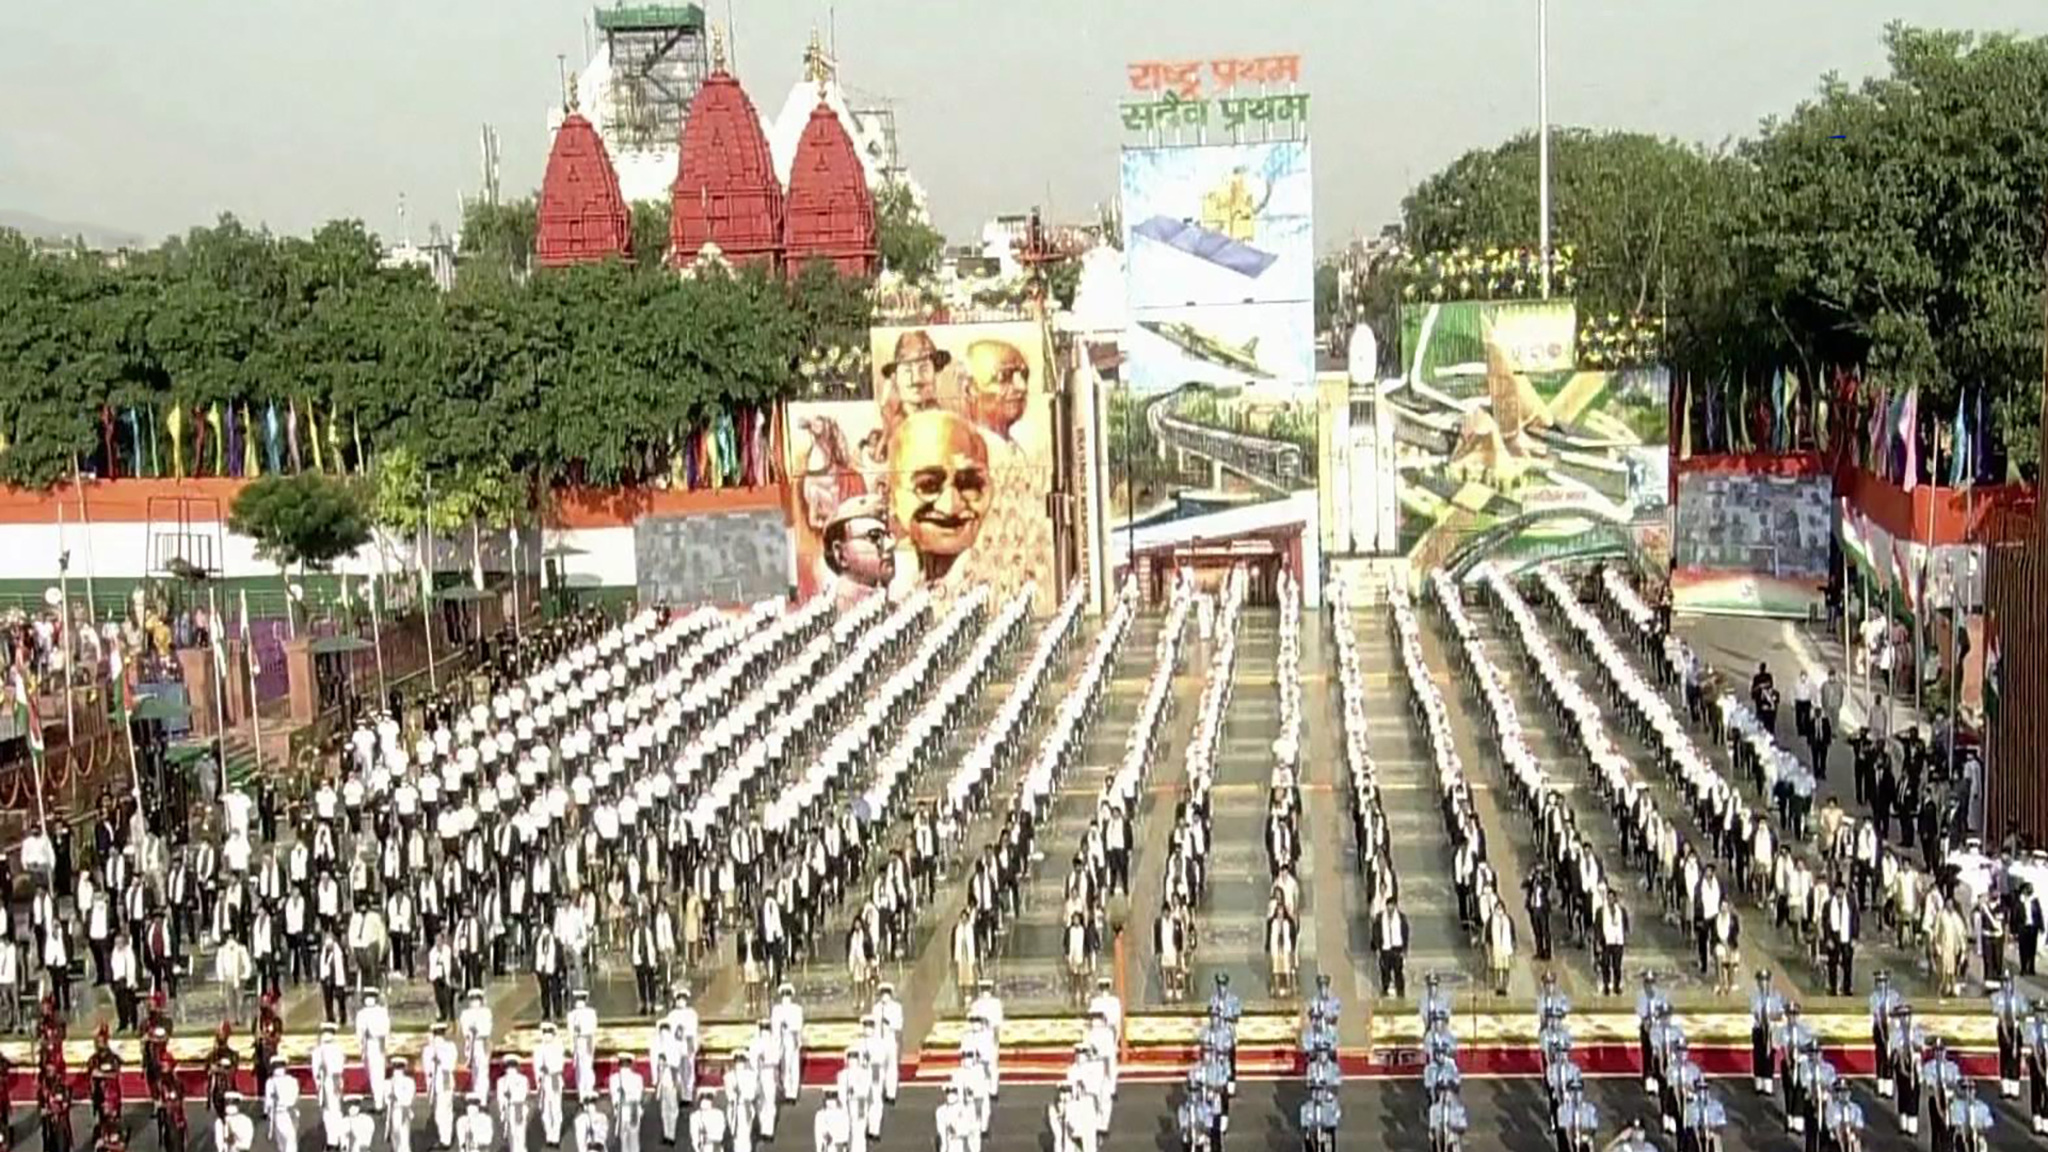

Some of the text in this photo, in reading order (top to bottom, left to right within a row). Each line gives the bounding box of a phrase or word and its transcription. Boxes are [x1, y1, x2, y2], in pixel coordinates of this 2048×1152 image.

[1127, 55, 1301, 97] राष्ट्र प्रथम
[1120, 89, 1310, 131] सदैव प्रथम
